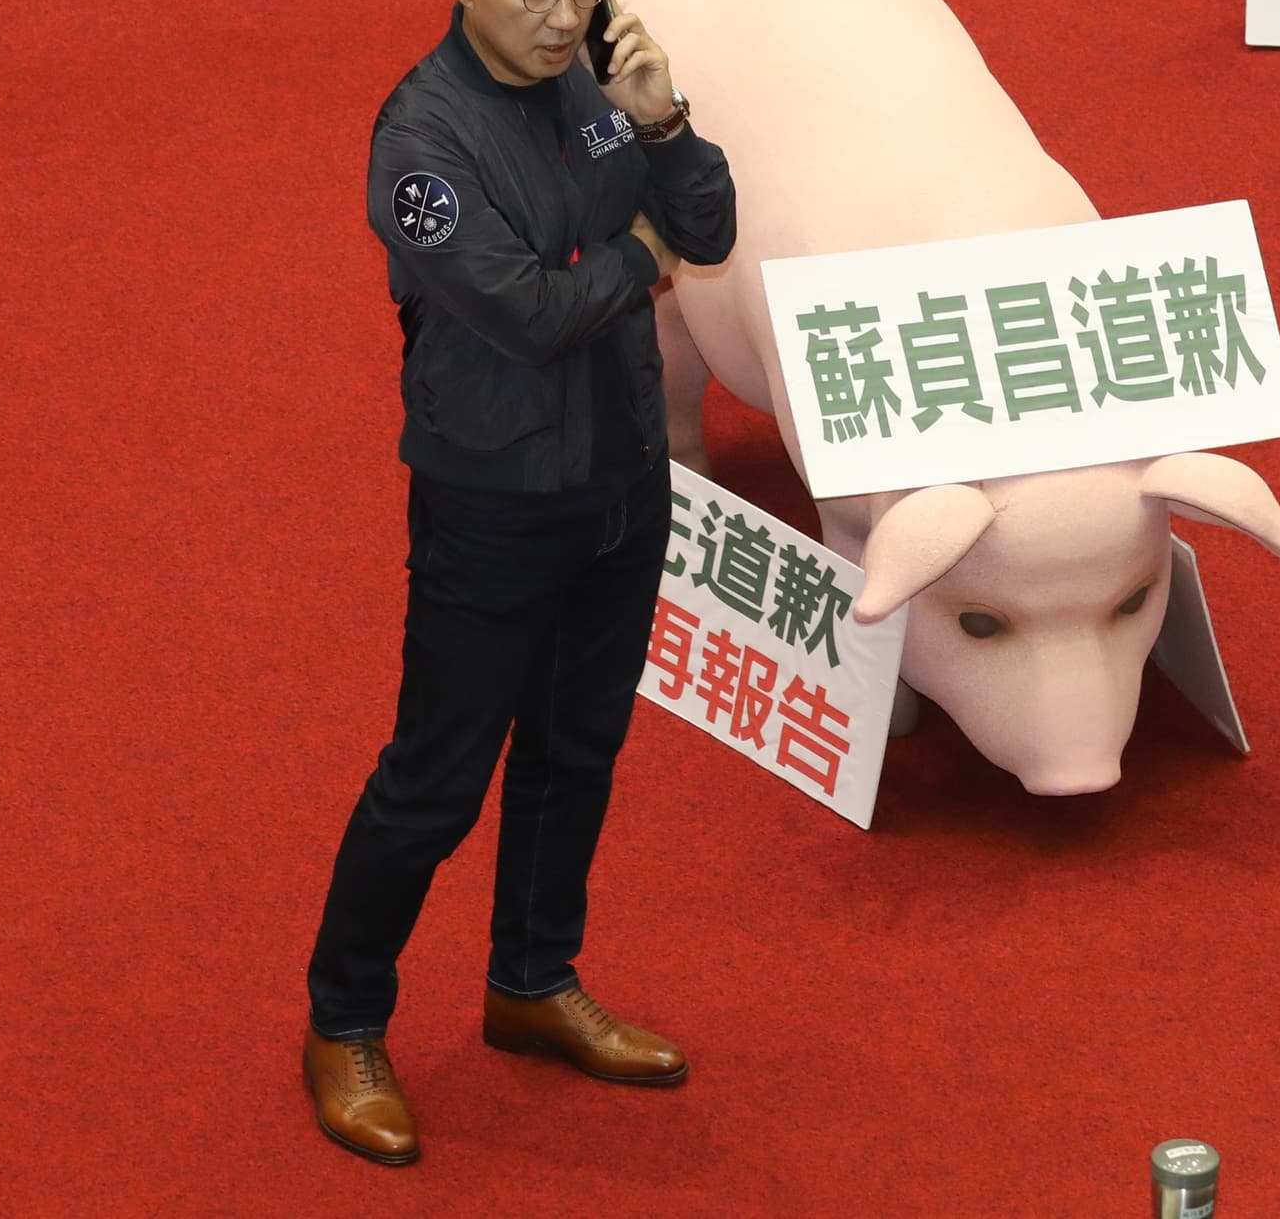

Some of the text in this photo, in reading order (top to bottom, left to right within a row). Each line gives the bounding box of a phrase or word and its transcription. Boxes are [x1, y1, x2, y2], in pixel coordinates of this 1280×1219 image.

[797, 255, 1266, 445] 蘇貞昌道歉
